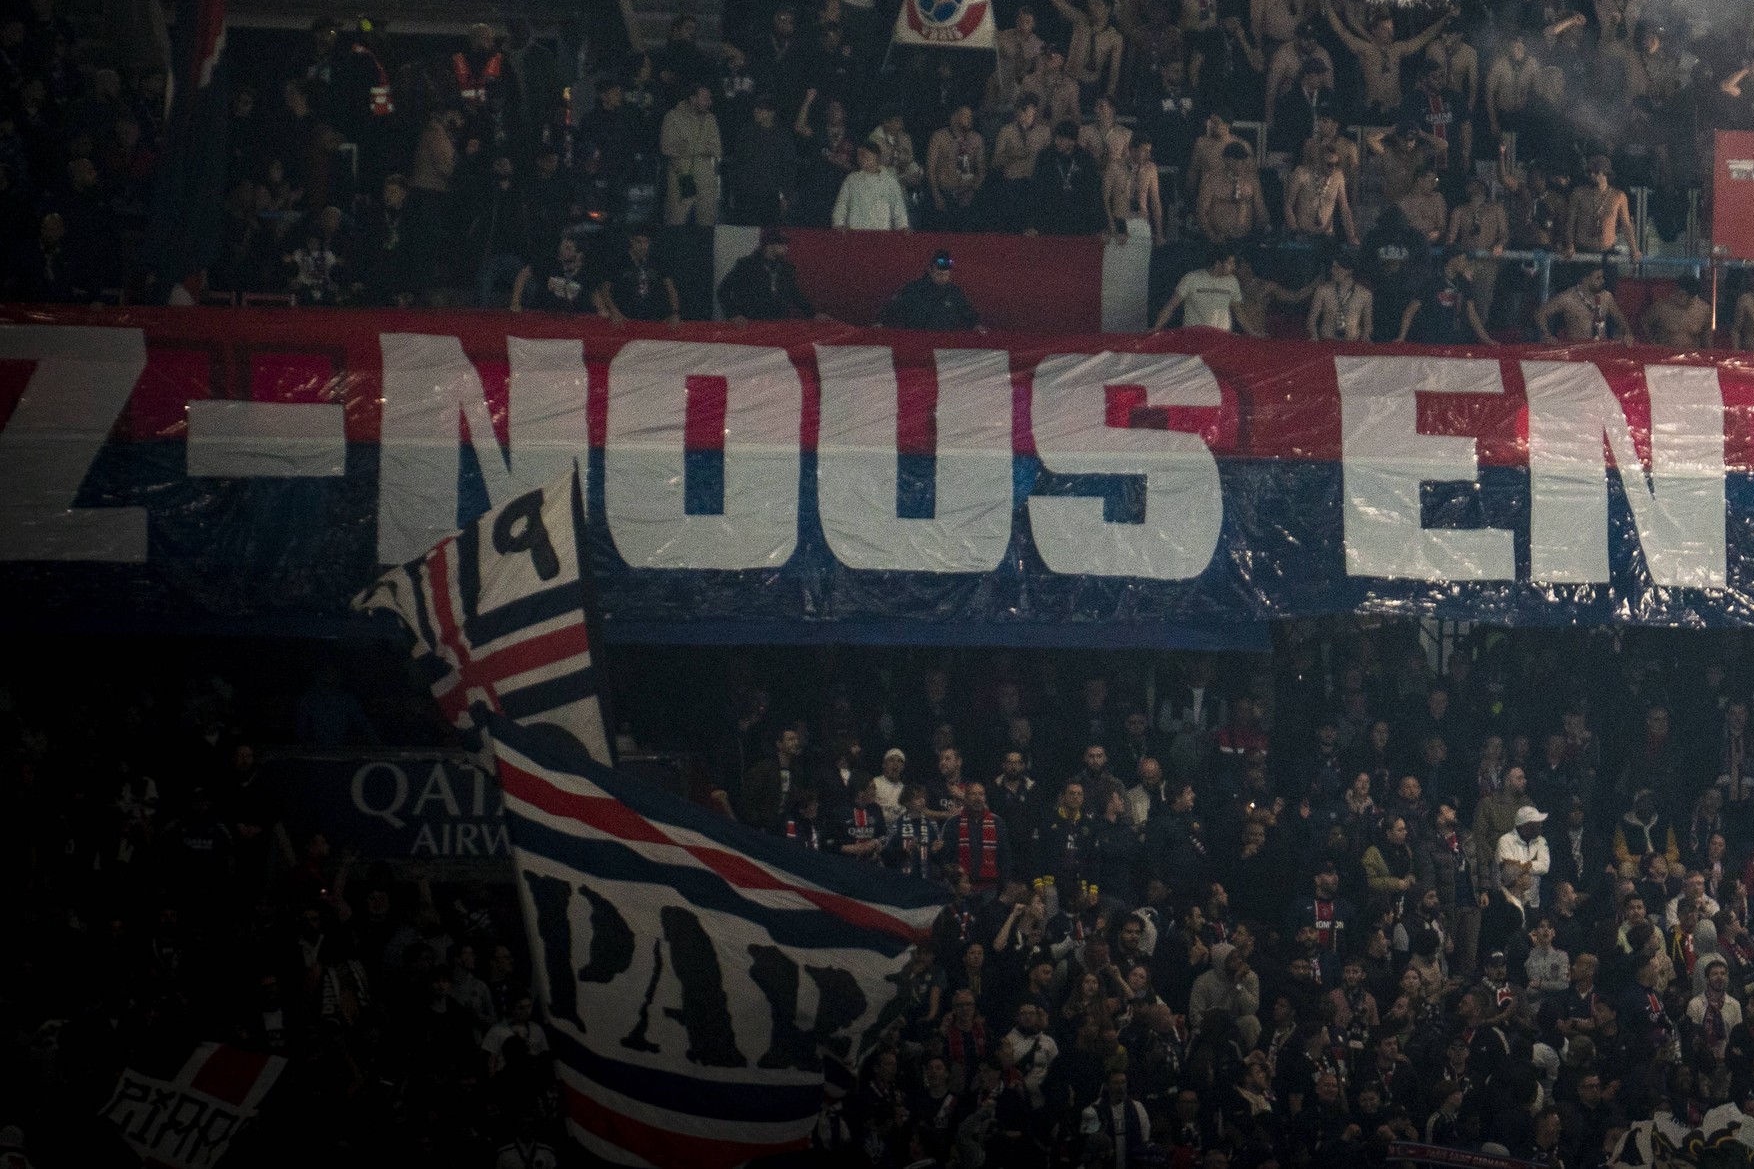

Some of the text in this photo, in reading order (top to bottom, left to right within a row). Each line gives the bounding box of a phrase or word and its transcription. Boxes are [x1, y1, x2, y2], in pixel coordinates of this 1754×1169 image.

[1334, 355, 1728, 588] EN
[351, 762, 505, 829] QAT
[410, 821, 512, 856] AIRW
